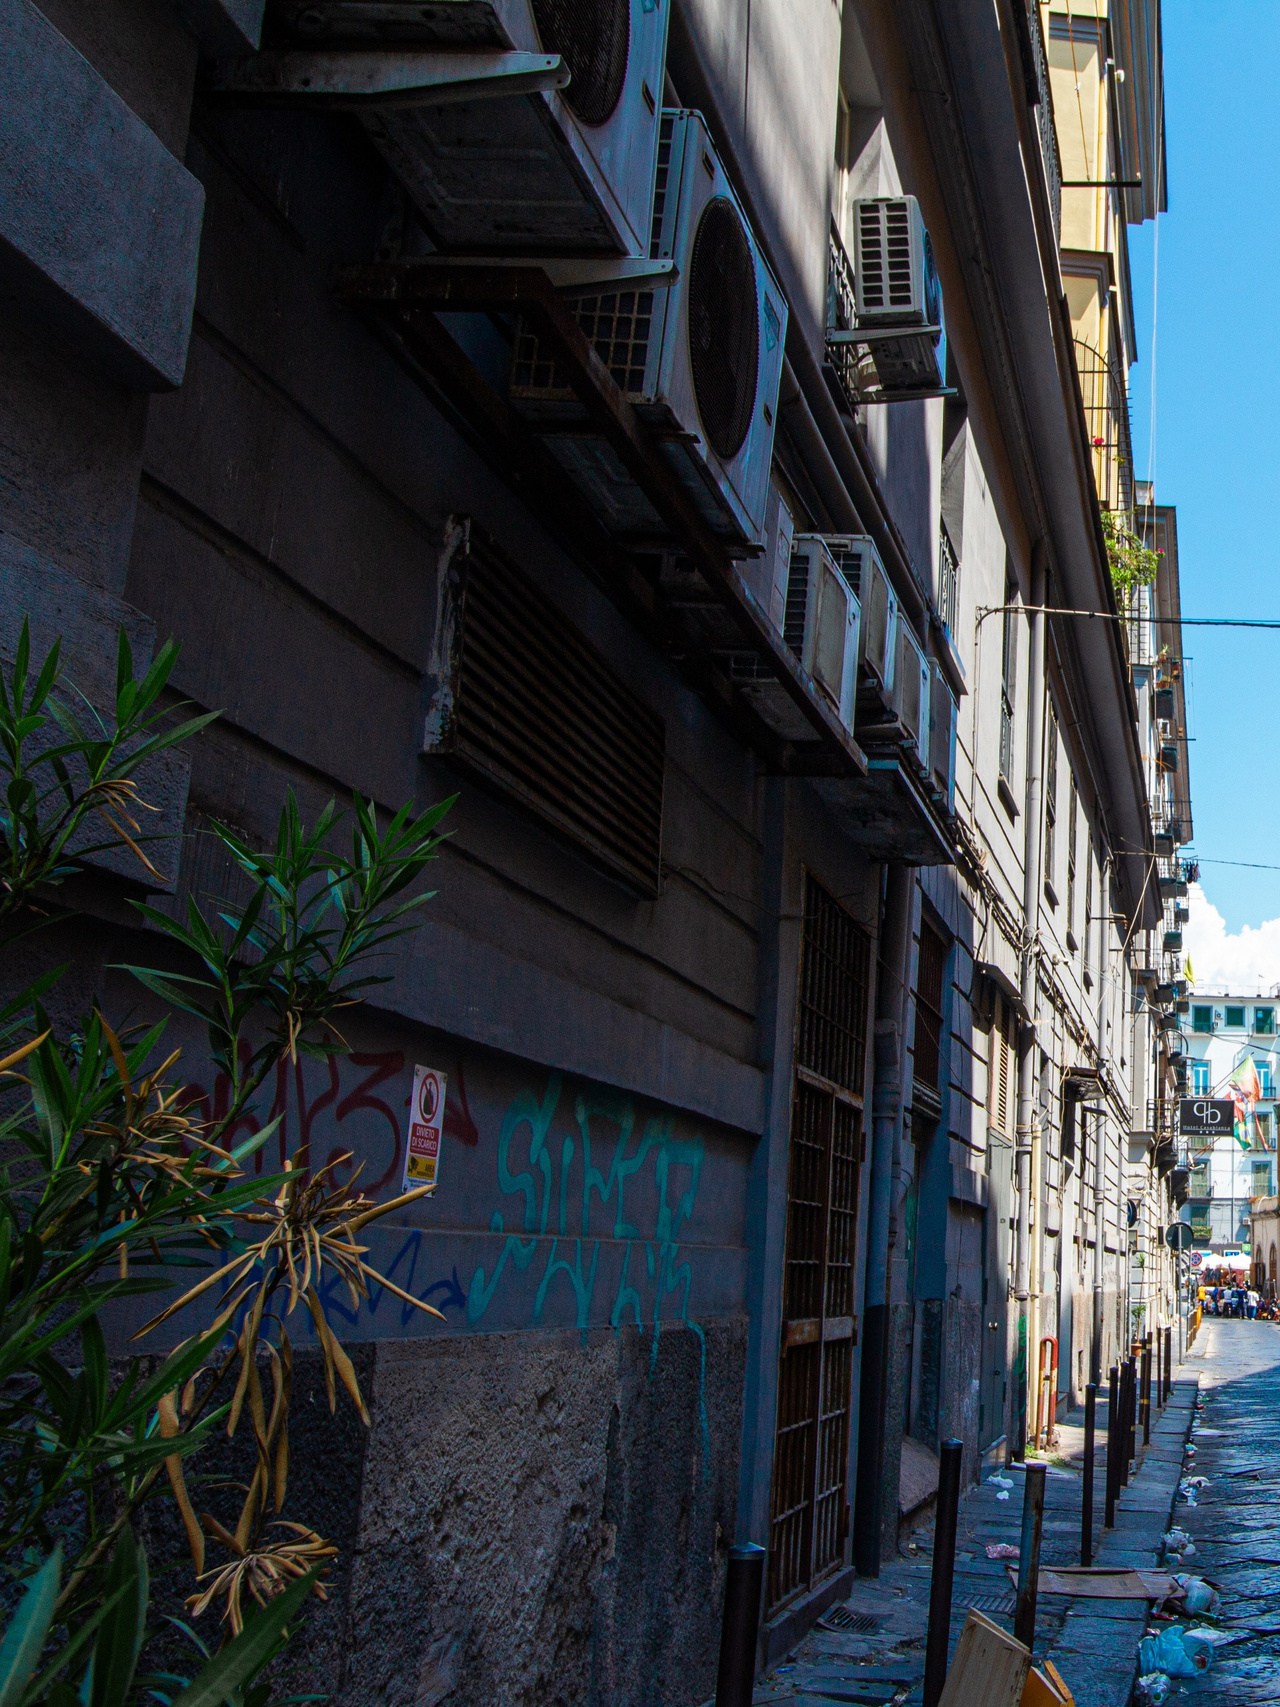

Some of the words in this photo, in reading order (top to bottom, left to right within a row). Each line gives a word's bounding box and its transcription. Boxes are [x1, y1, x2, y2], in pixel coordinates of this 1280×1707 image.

[416, 1126, 435, 1139] DIVIETO
[411, 1136, 418, 1147] DI
[418, 1138, 437, 1151] SCARICO
